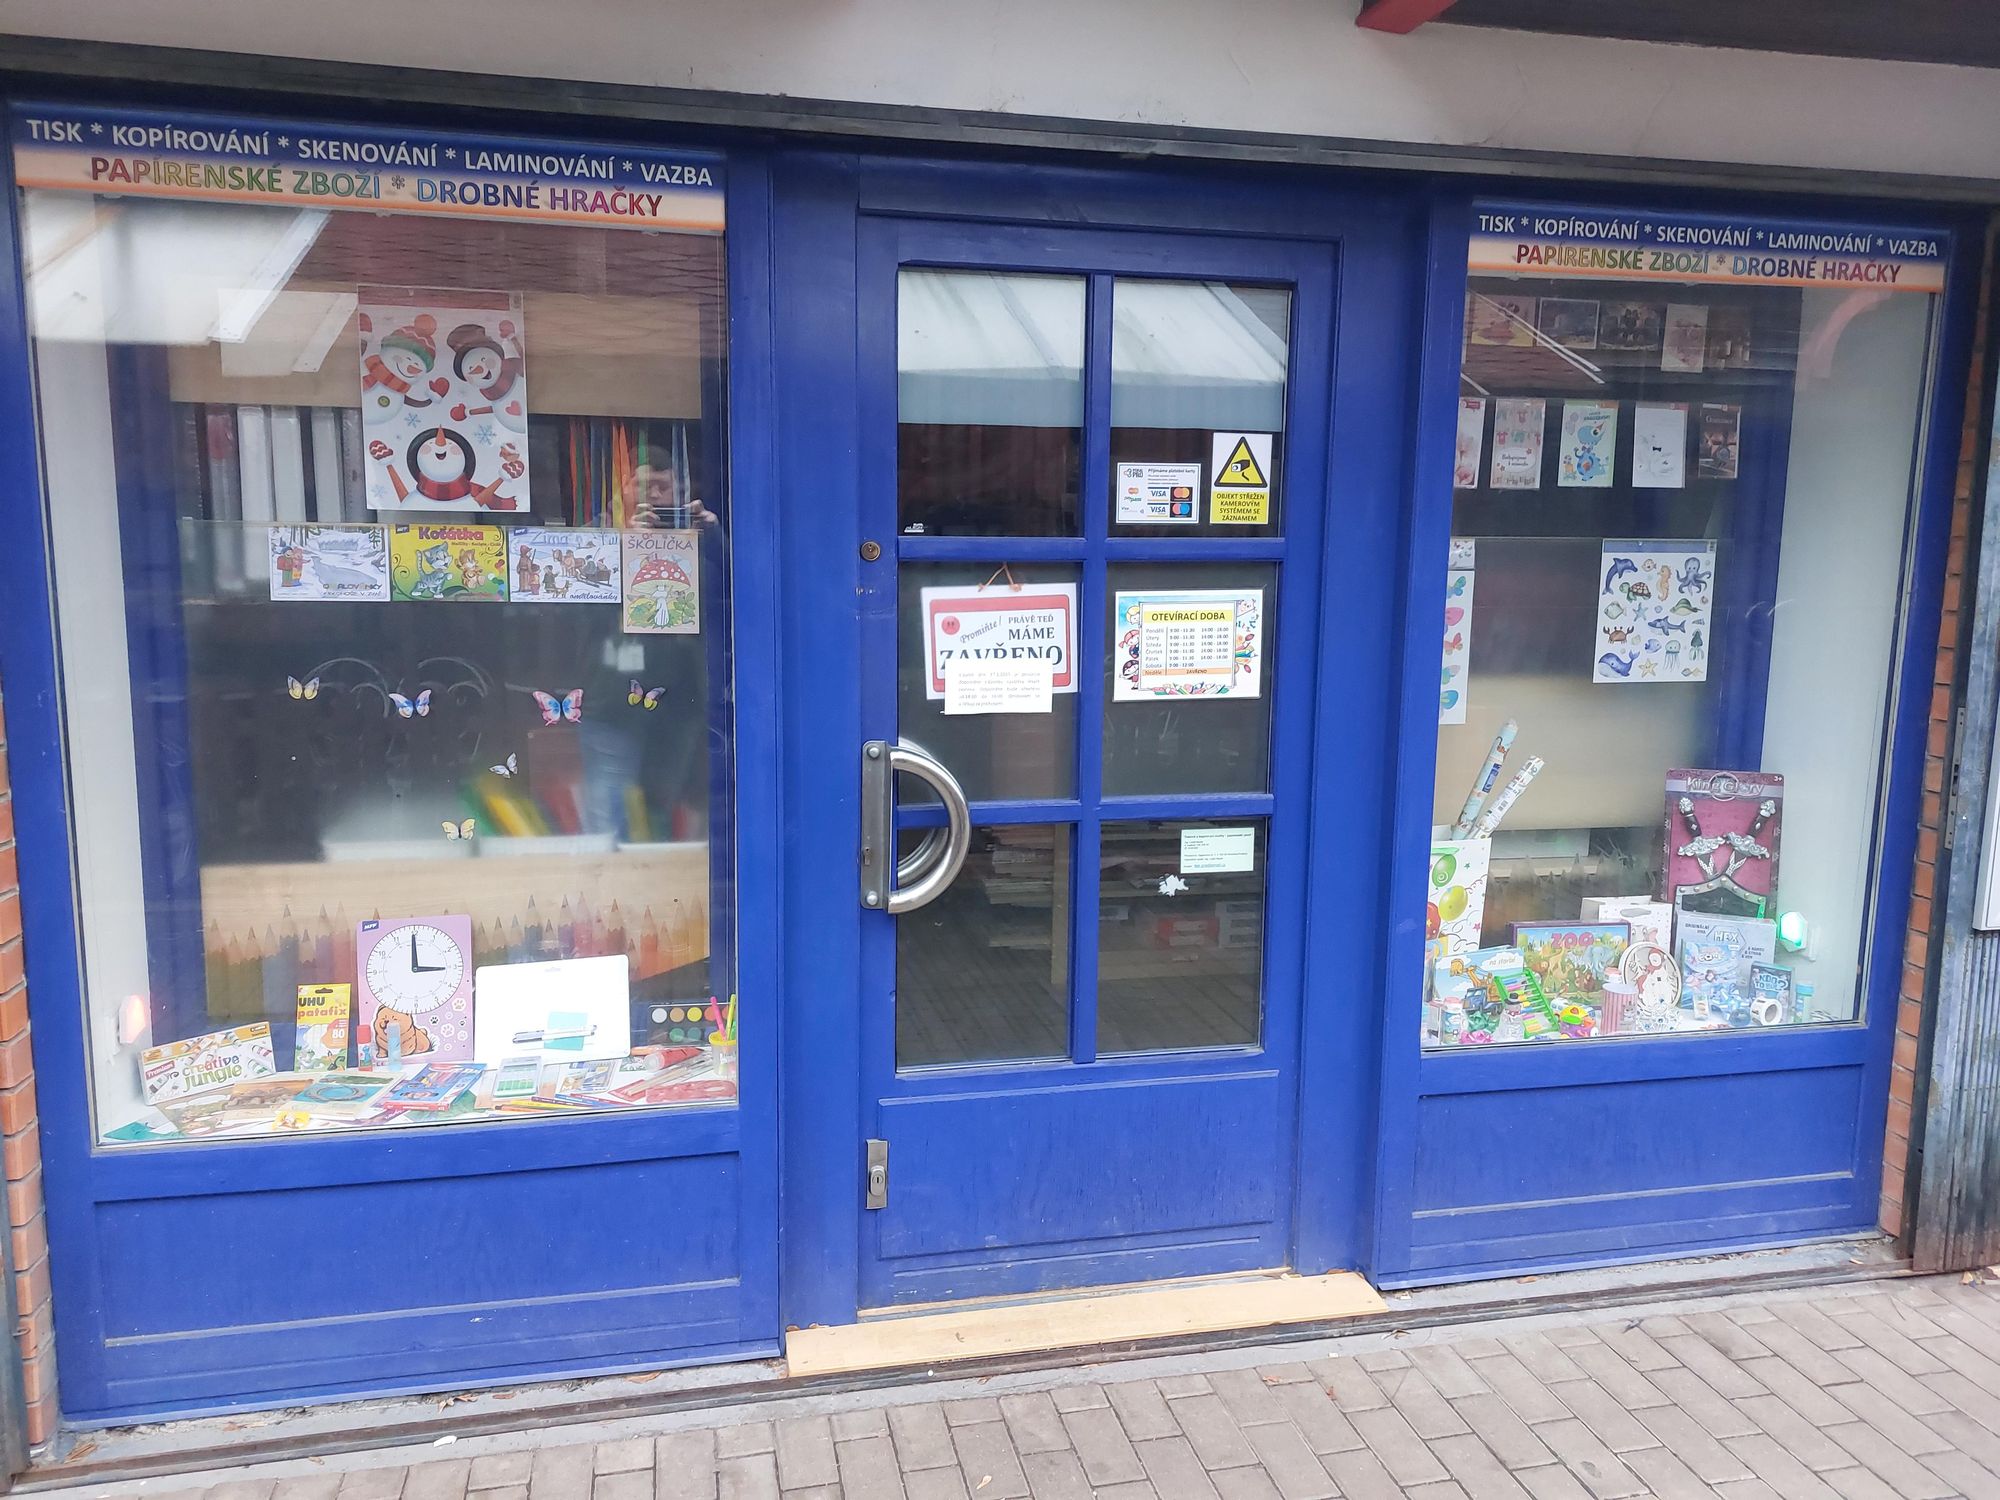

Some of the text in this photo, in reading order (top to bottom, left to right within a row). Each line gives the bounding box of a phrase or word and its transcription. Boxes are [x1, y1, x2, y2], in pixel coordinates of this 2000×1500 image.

[26, 118, 713, 187] TISK KOPÍROVÁNÍ SKENOVÁNÍ LAMINOVÁNÍ VAZBA
[90, 155, 663, 218] PAPÍRENSKÉ ZBOŽÍ DROBNÉ HRAČKY
[1478, 214, 1938, 257] TISK KOPÍROVÁNÍ SKENOVÁNÍ LAMINOVÁNÍ VAZBA
[1516, 241, 1902, 284] PAPÍRENSKÉ ZBOŽÍ DROBNÉ HRAČKY
[1216, 492, 1265, 500] OBJEKT STŘEŽEN
[1221, 514, 1258, 522] ZÁZNAMEM
[418, 525, 484, 541] Koťátka
[627, 535, 694, 551] ŠKOLIČKA
[1151, 610, 1226, 622] OTEVÍRACÍ DOBA
[1008, 624, 1055, 641] MÁME
[1686, 776, 1720, 793] King
[1551, 931, 1595, 949] ZOO
[1713, 930, 1740, 944] HEX
[298, 996, 326, 1008] UHU
[297, 1006, 347, 1020] patafix
[331, 1028, 346, 1039] 80
[182, 1054, 240, 1077] creative
[182, 1064, 243, 1093] jungle
